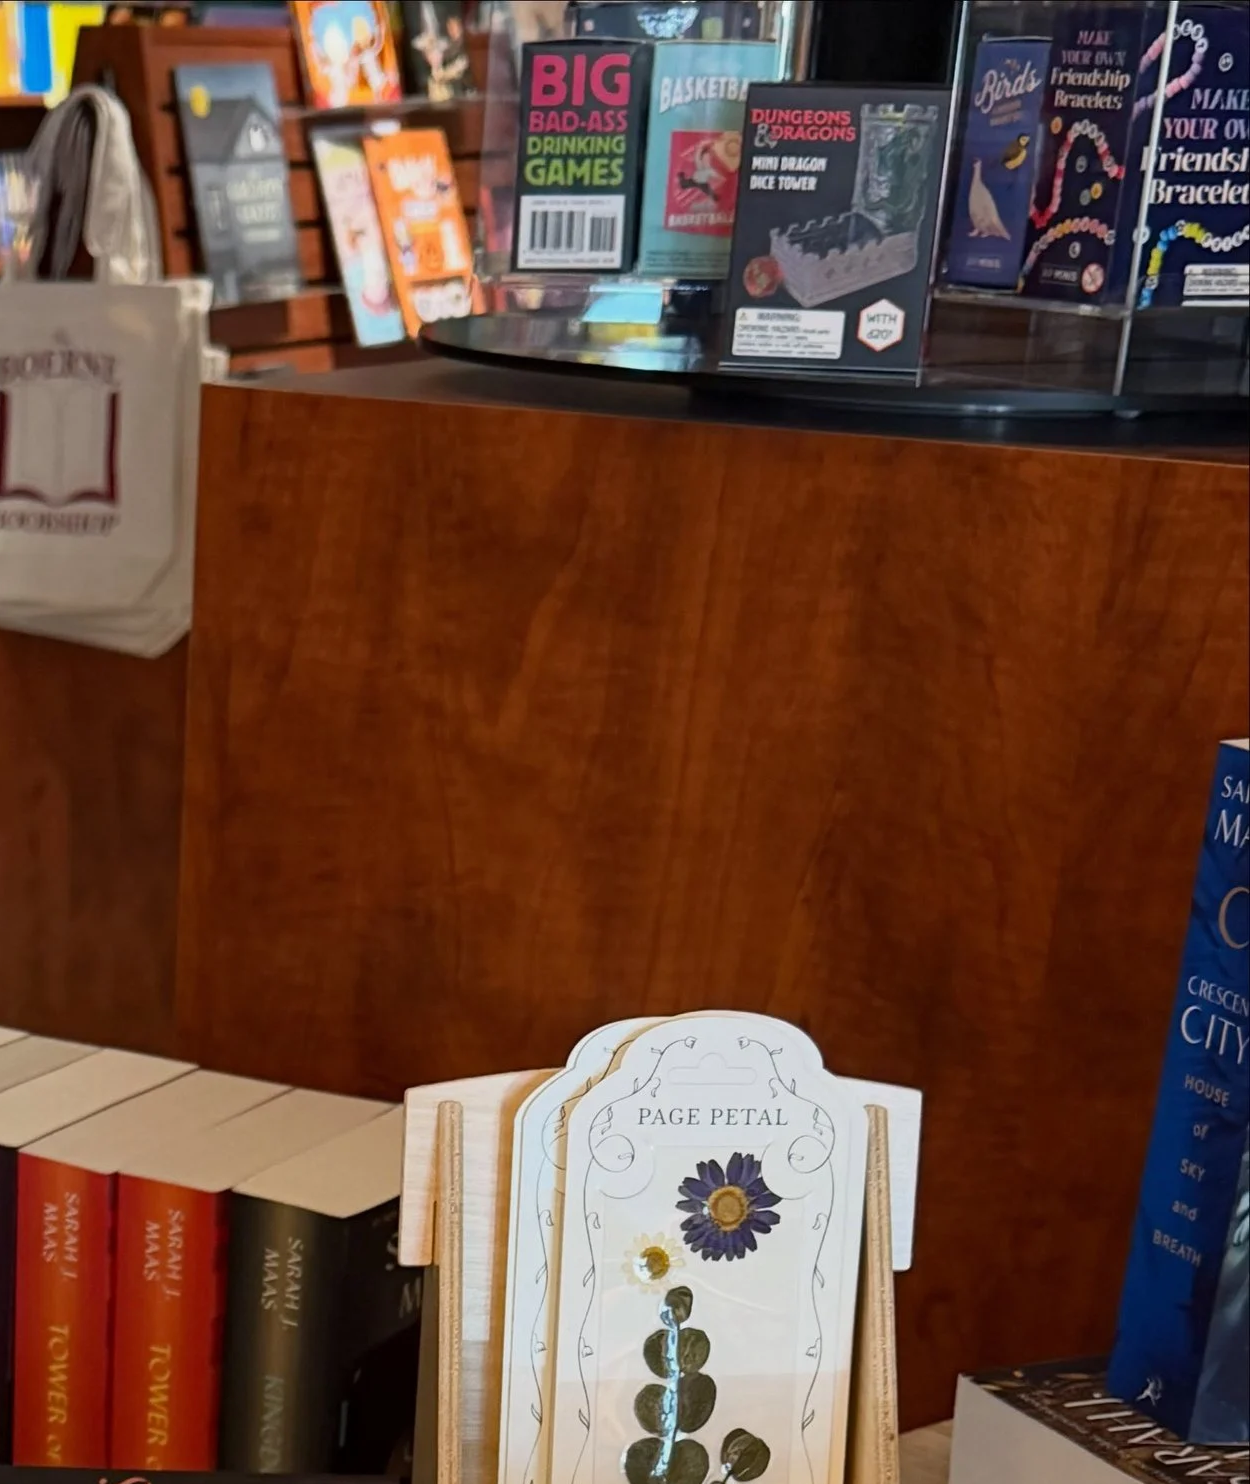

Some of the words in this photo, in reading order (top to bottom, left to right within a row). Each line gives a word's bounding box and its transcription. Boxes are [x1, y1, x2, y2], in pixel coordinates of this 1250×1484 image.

[531, 54, 631, 107] BIG
[975, 60, 1042, 114] Birds
[1050, 68, 1131, 91] Friendship
[1054, 90, 1123, 110] Bracelets
[1191, 88, 1250, 111] MAKE
[528, 111, 628, 133] BAD-ASS
[751, 108, 850, 125] DUNGEONS
[770, 125, 856, 142] DRAGONS
[1163, 117, 1219, 140] YOUR
[526, 134, 626, 156] DRINKING
[524, 158, 624, 187] GAMES
[751, 157, 778, 172] MINI
[780, 157, 827, 172] DRAGON
[750, 175, 776, 190] DICE
[778, 176, 817, 191] TOWER
[867, 313, 897, 325] WITH
[1181, 1005, 1250, 1064] CITY
[1184, 1073, 1230, 1108] HOUSE
[638, 1108, 701, 1126] PAGE
[709, 1108, 789, 1127] PETAL
[1179, 1158, 1206, 1182] SKY
[1171, 1199, 1197, 1222] and
[1152, 1229, 1202, 1267] BREATH
[261, 1248, 280, 1311] MAAS
[284, 1236, 304, 1311] SARAH
[48, 1324, 70, 1424] TOWER
[146, 1344, 171, 1446] TOWER
